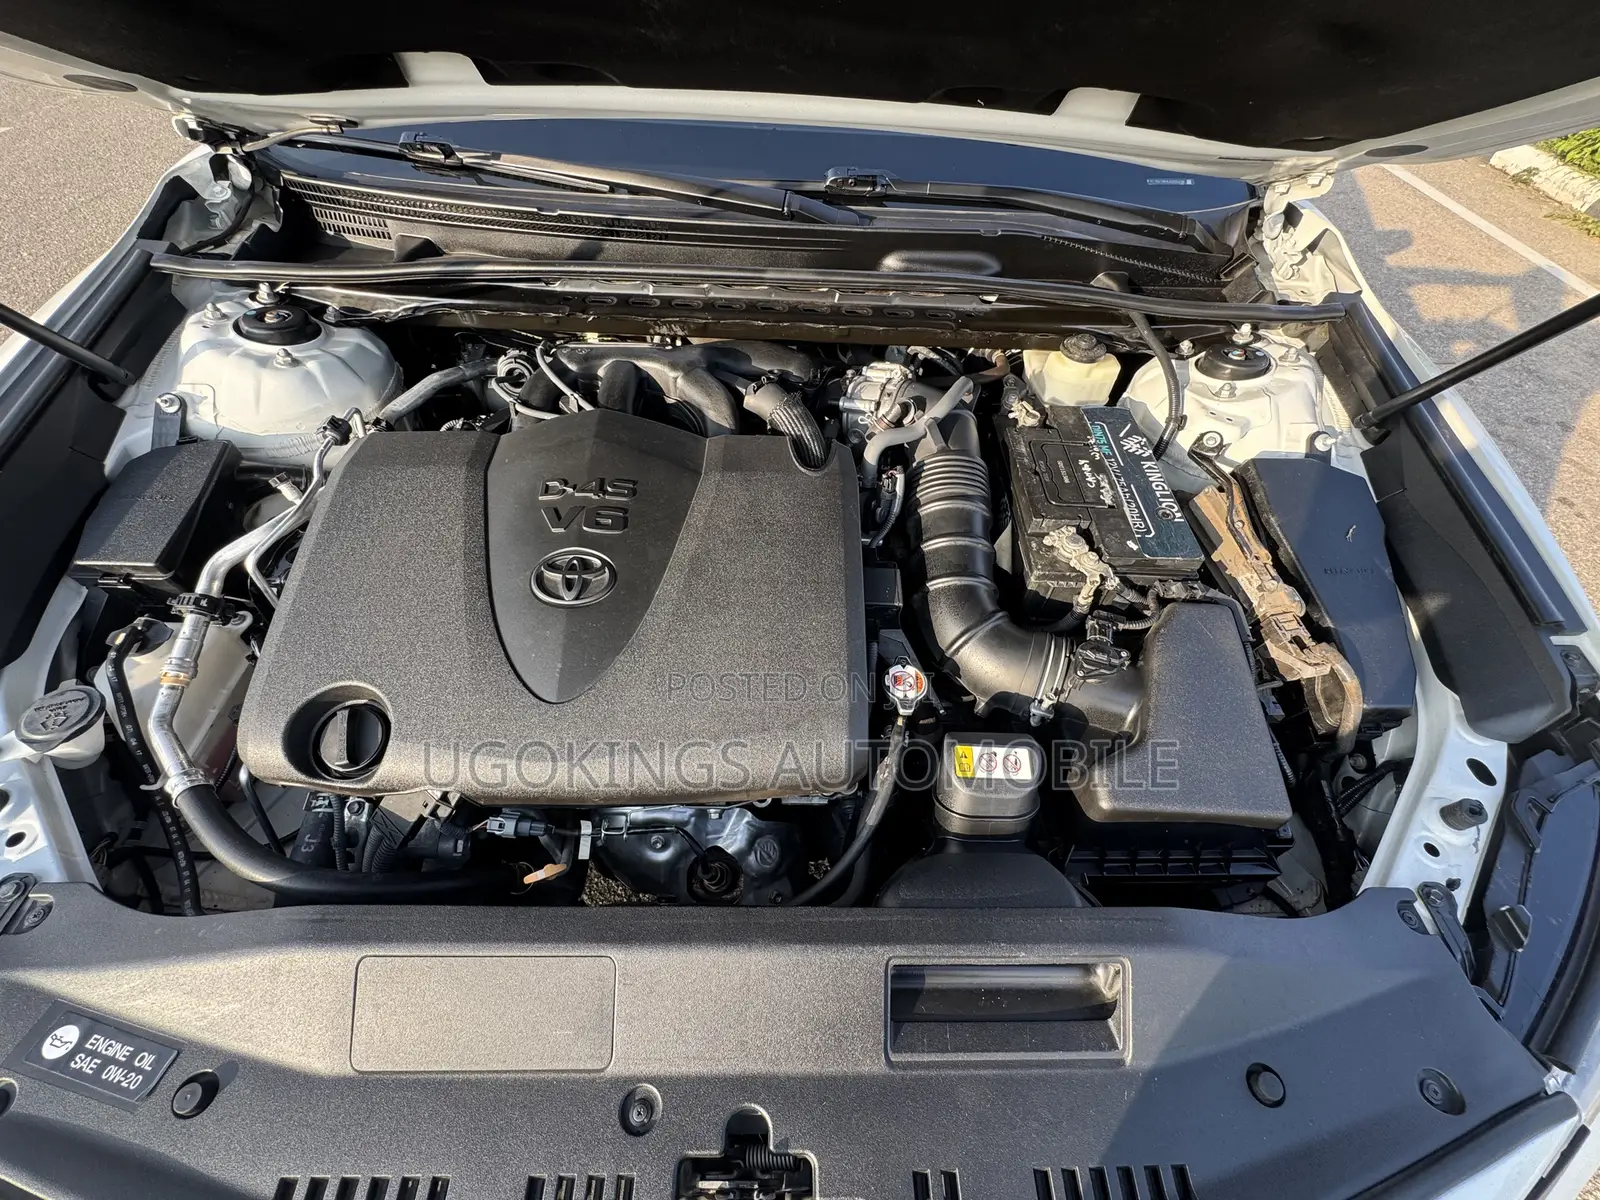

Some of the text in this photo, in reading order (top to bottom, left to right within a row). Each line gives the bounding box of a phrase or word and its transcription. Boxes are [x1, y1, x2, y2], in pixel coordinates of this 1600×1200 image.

[1141, 461, 1184, 522] KINGLION
[541, 505, 629, 534] V6
[85, 1034, 156, 1070] ENGINE OIL
[71, 1054, 143, 1090] SAE 0W-20
